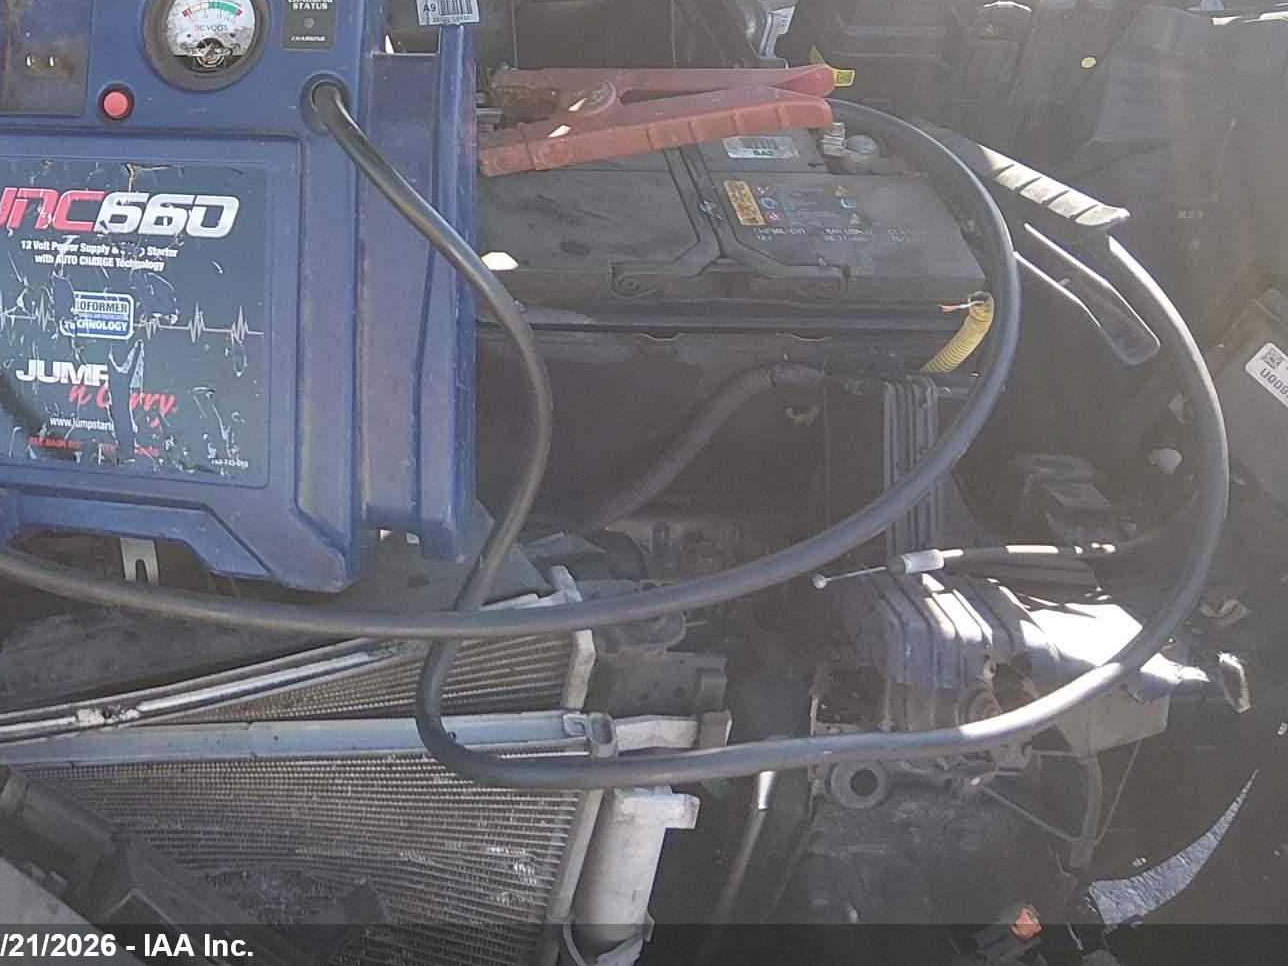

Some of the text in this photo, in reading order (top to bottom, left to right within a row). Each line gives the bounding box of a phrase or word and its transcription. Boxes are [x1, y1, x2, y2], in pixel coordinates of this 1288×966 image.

[292, 2, 328, 10] STATUS
[423, 3, 436, 12] A9
[20, 240, 31, 250] 12
[32, 241, 50, 251] Volt
[79, 243, 111, 256] Supply
[146, 246, 178, 258] Starter
[34, 253, 165, 272] with AUTO CHARGE Technology
[96, 386, 177, 421] Crry
